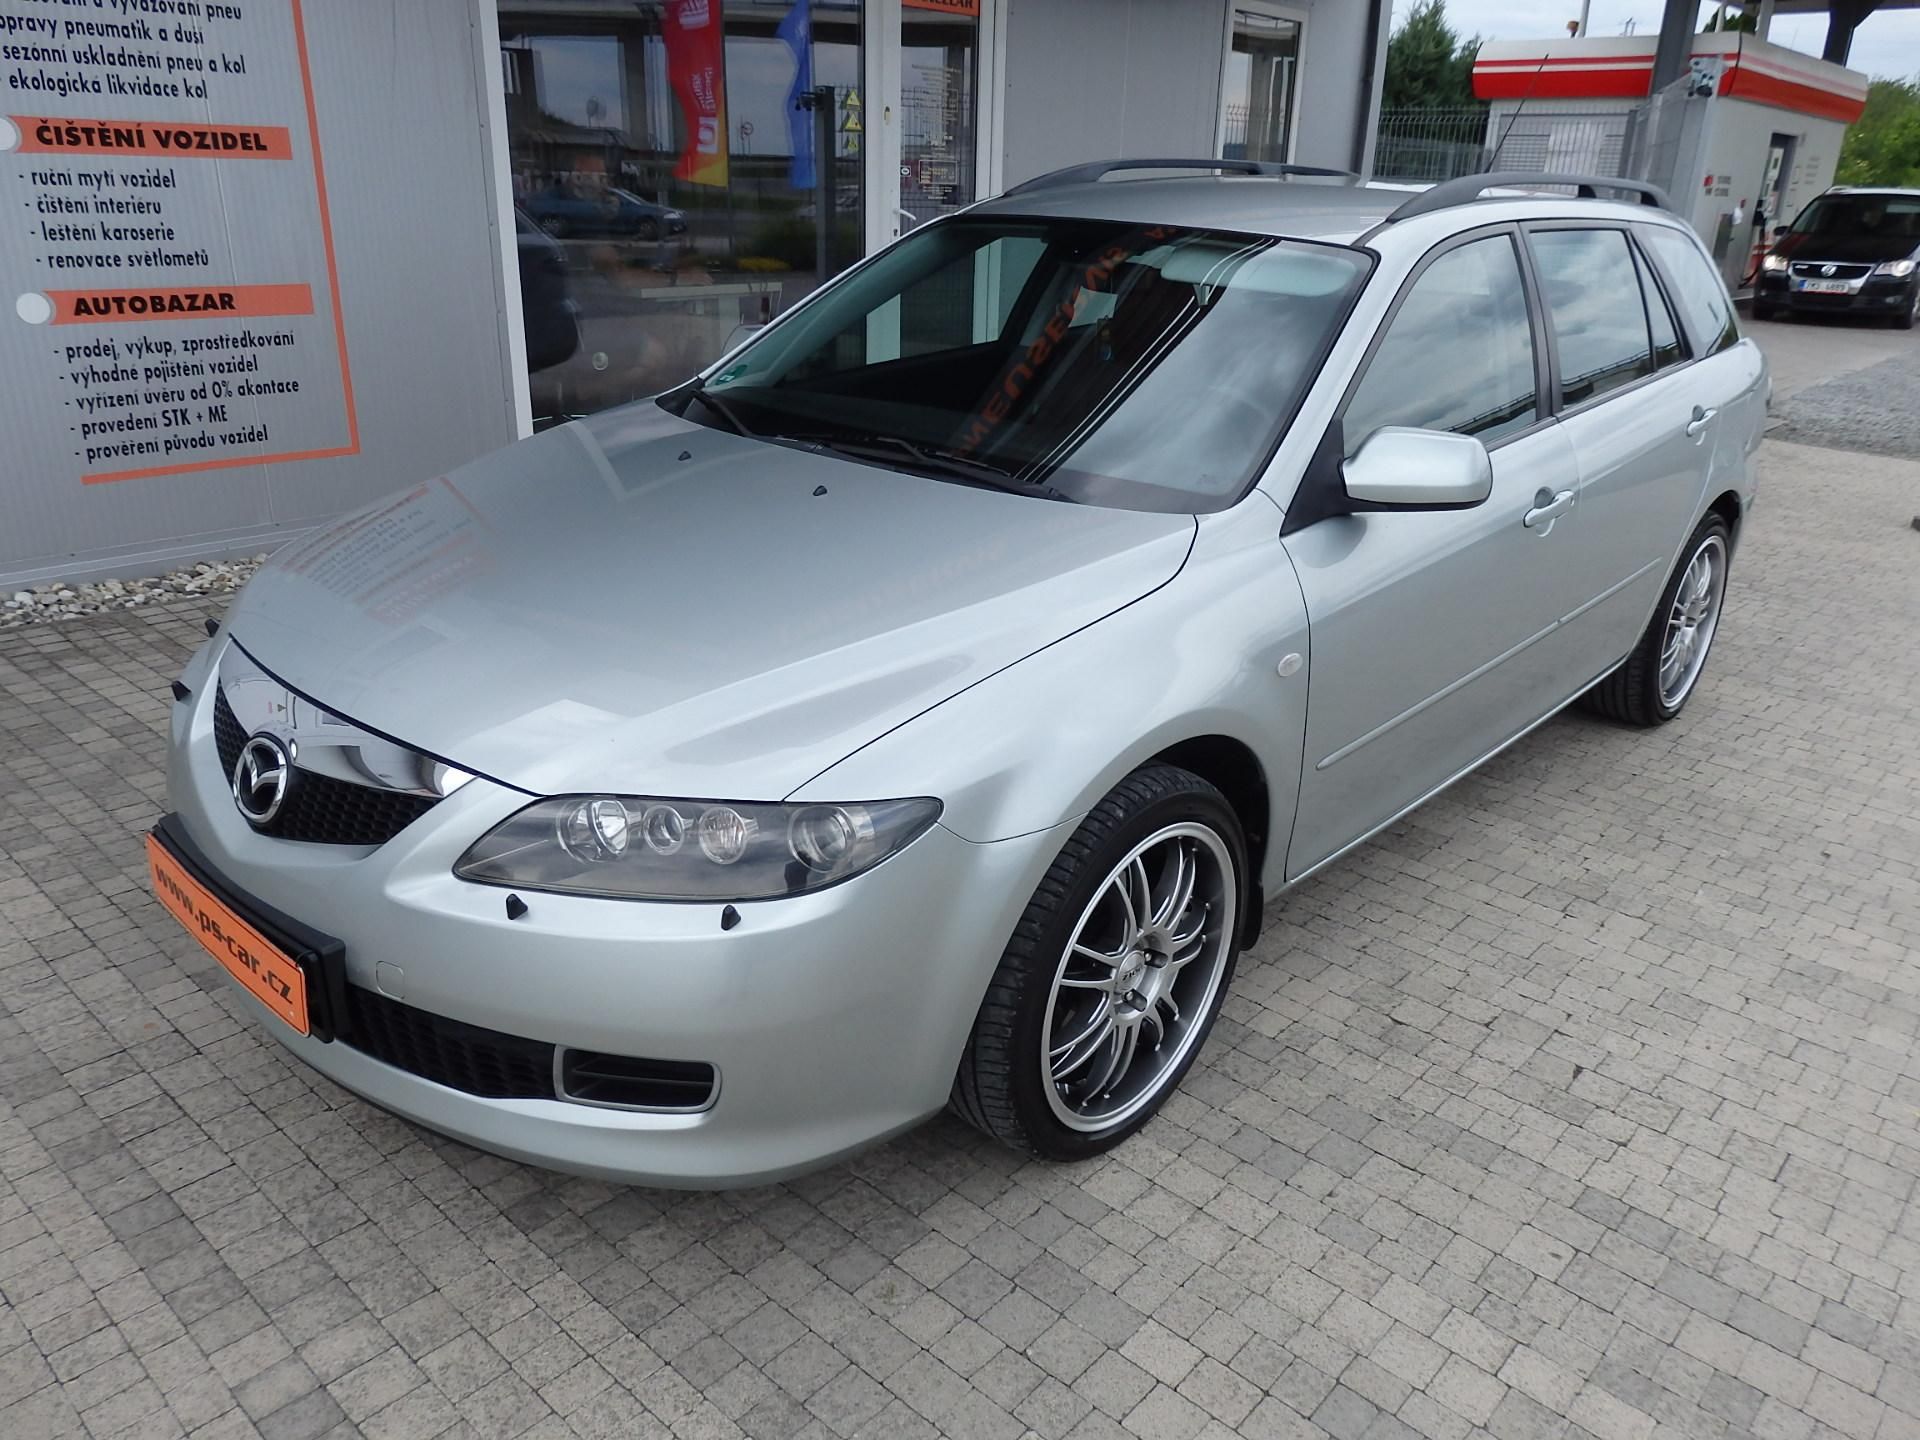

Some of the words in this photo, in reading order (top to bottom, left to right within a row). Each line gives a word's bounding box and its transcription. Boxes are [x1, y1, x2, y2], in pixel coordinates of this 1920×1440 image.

[206, 4, 242, 22] pneu
[64, 19, 153, 41] pneumatik
[159, 28, 168, 41] a
[3, 42, 68, 63] sezónní
[72, 43, 162, 69] uskladnění
[166, 56, 203, 75] pneu
[208, 59, 218, 72] a
[221, 52, 246, 74] kol
[9, 67, 102, 97] ekologická
[106, 73, 179, 97] likvidace
[183, 77, 208, 99] kol
[36, 119, 146, 148] ČIŠTĚNÍ
[152, 129, 268, 151] VOZIDEL
[31, 168, 73, 186] ruční
[121, 168, 177, 188] vozidel
[37, 194, 89, 214] čištění
[94, 194, 162, 214] interiéru
[41, 221, 97, 241] leštění
[101, 221, 175, 241] karoserie
[48, 254, 122, 268] renovace
[128, 248, 209, 267] světlometů
[74, 293, 236, 316] AUTOBAZAR
[66, 338, 120, 363] prodej,
[125, 335, 177, 360] výkup,
[181, 330, 295, 356] zprostředkování
[71, 361, 139, 389] výhodné
[144, 359, 205, 383] pojištění
[208, 354, 258, 375] vozidel
[76, 389, 140, 415] vyřízení
[144, 387, 186, 404] úvěru
[190, 381, 207, 399] od
[212, 379, 233, 398] 0%
[237, 378, 300, 397] akontace
[81, 412, 158, 440] provedení
[162, 407, 191, 428] STK
[208, 404, 228, 424] ME
[86, 437, 160, 464] prověření
[164, 430, 216, 455] původu
[219, 424, 268, 447] vozidel
